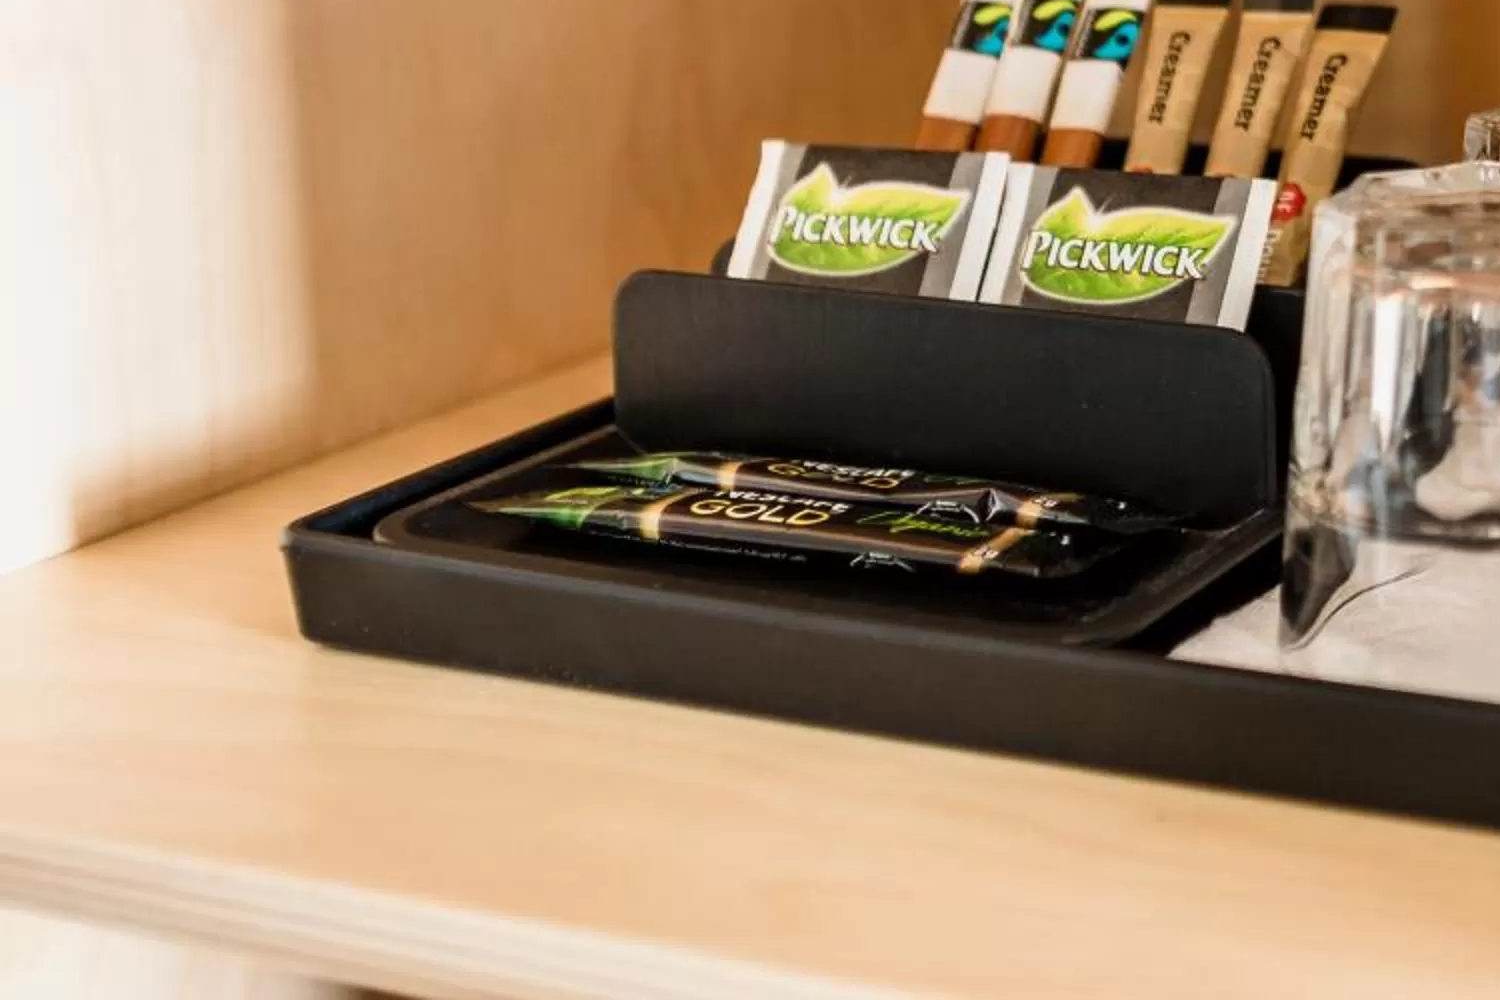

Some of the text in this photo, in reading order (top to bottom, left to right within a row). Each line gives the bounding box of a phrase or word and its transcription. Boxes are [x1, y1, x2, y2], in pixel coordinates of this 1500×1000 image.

[1149, 30, 1191, 124] Creamer
[1234, 35, 1281, 132] Creamer
[1300, 53, 1348, 142] Creamer
[770, 204, 939, 253] PICKWICK
[1021, 231, 1205, 280] PICKWICK
[690, 499, 830, 526] GOLD
